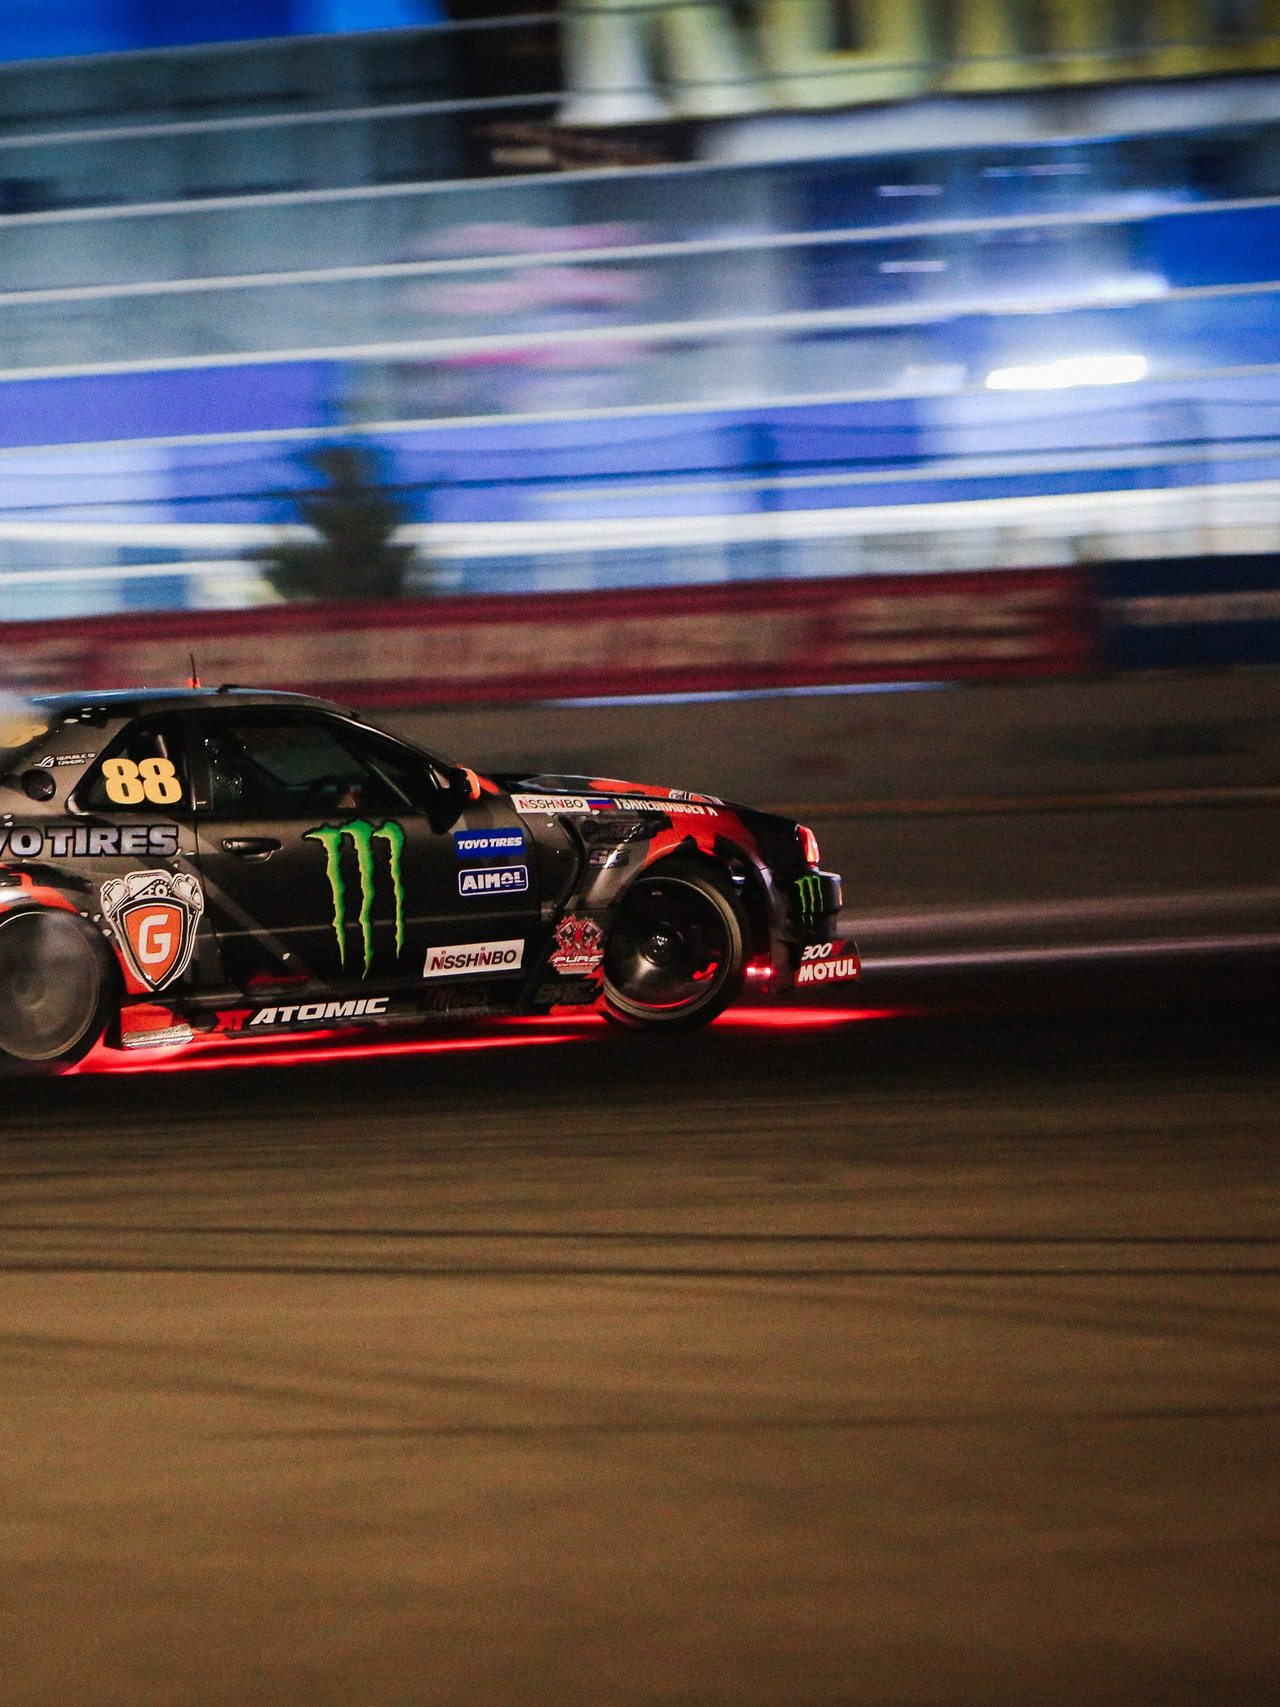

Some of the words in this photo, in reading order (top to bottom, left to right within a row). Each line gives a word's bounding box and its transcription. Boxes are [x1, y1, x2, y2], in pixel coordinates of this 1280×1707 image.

[102, 757, 182, 805] 88
[46, 824, 179, 858] TIRES
[458, 839, 489, 850] TOYO
[489, 836, 523, 848] TIRES
[462, 871, 525, 891] AIMOL
[138, 913, 172, 964] G
[552, 954, 604, 963] PURE
[798, 958, 857, 982] MOTUL
[249, 997, 390, 1026] ATOMIC
